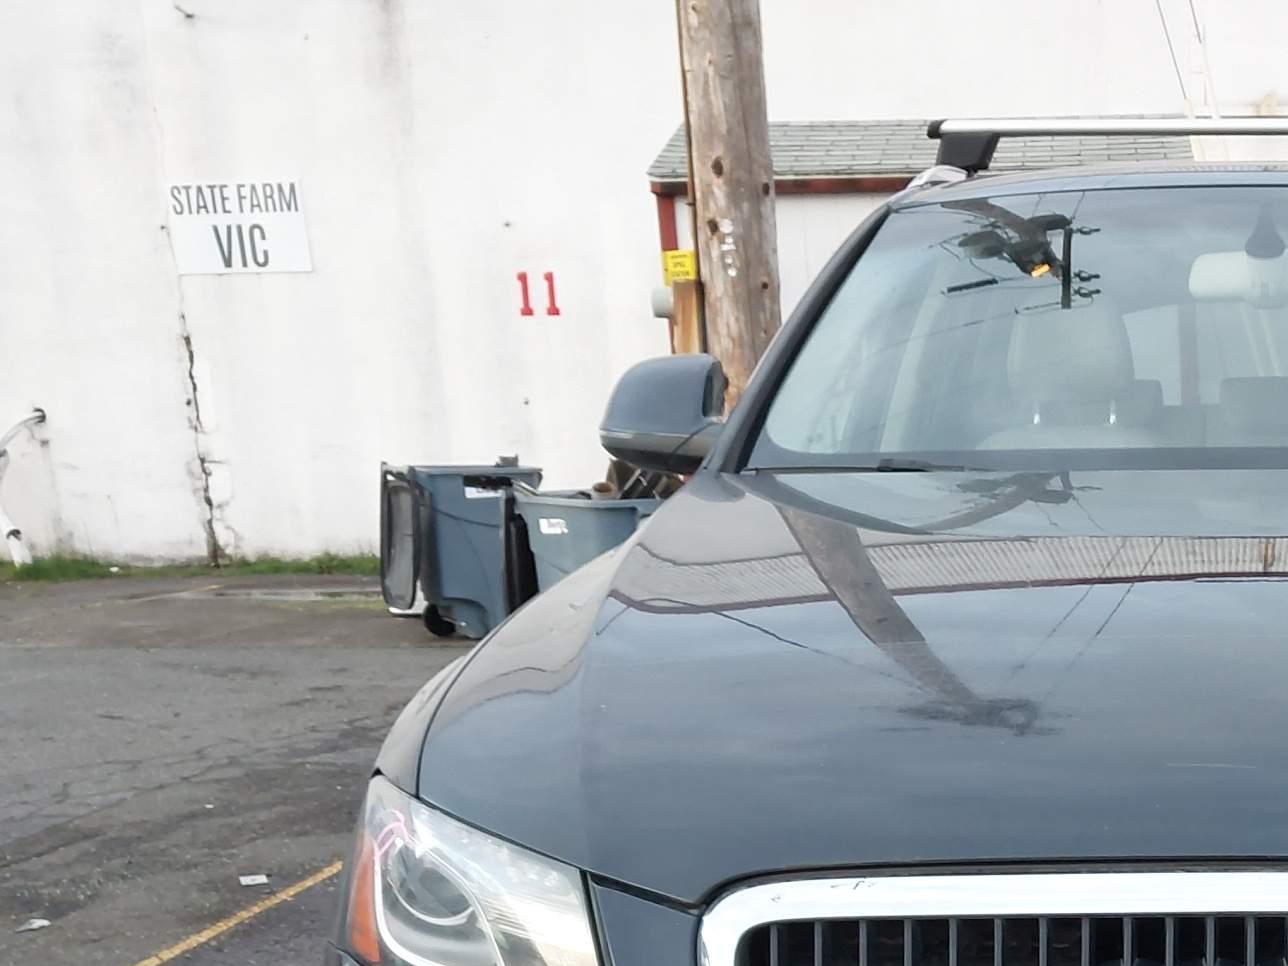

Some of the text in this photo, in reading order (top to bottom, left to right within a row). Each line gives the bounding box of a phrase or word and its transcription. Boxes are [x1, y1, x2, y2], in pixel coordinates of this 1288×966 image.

[170, 182, 299, 215] STATE FARM
[212, 223, 269, 268] VIC
[517, 272, 560, 316] 11
